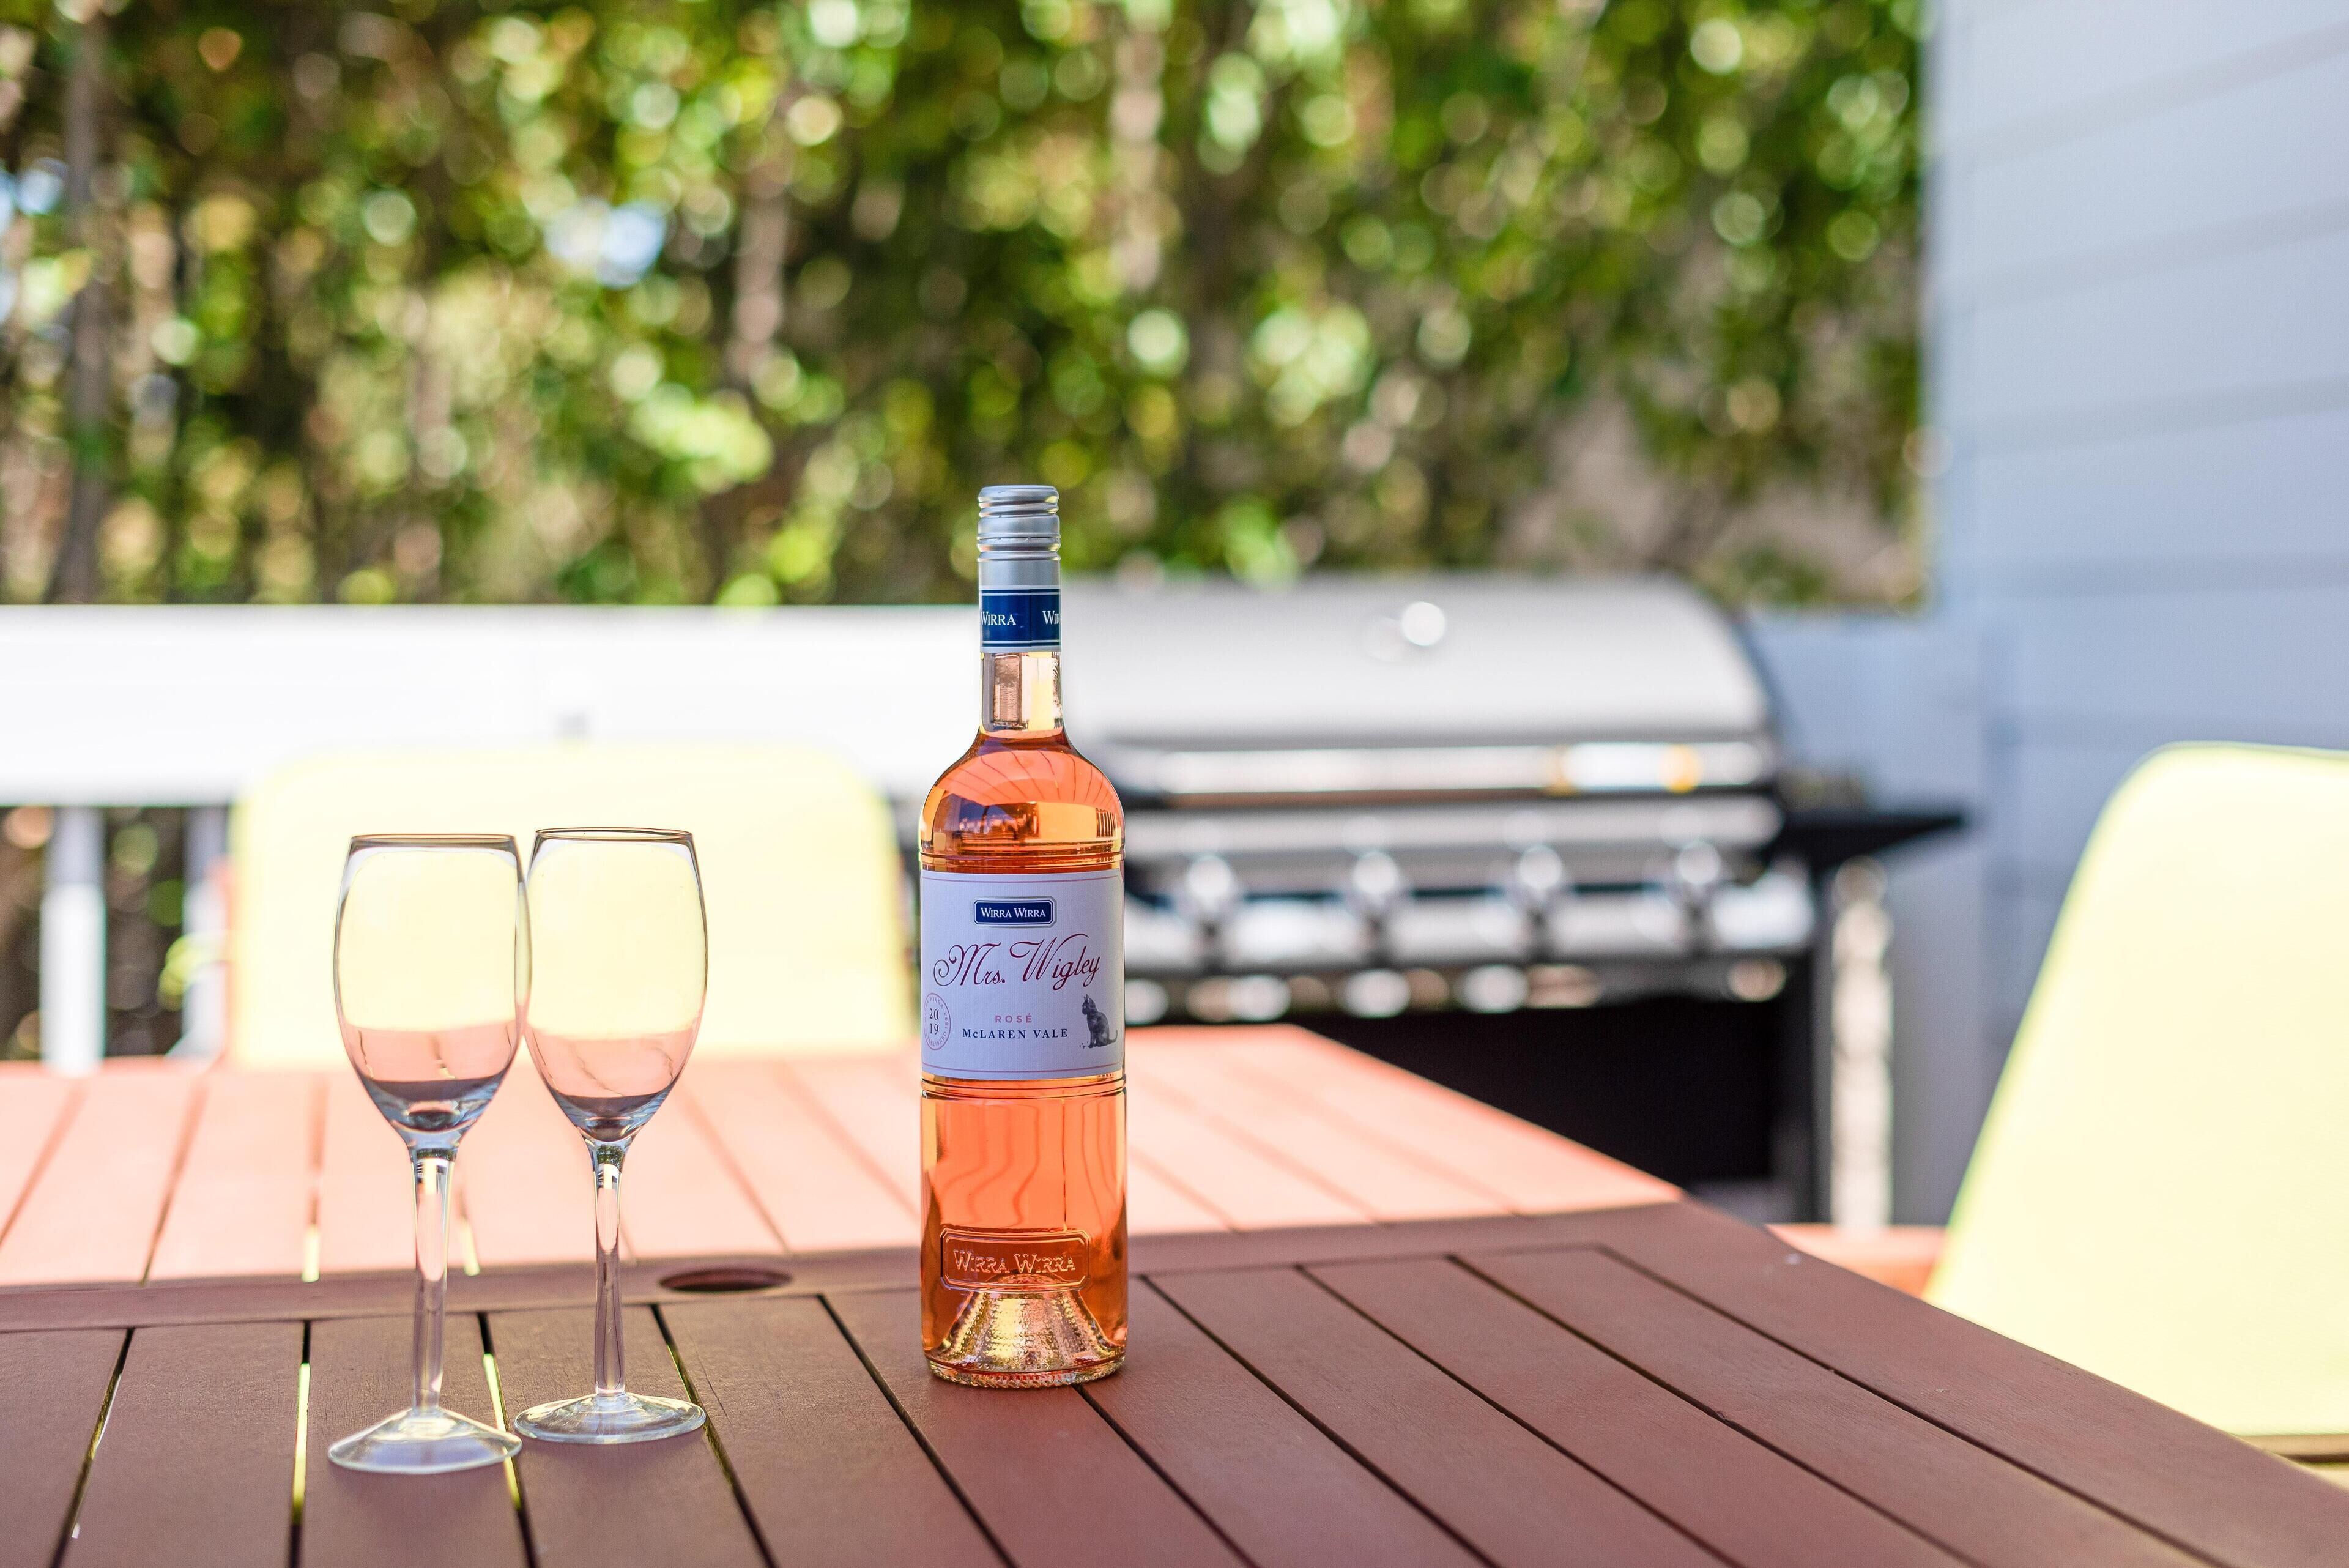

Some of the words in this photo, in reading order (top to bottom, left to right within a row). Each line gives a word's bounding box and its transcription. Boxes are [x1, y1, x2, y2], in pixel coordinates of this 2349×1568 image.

[980, 907, 1012, 918] WIRRA
[1014, 907, 1046, 918] WIRRA
[933, 942, 1006, 986] Mrs.
[1009, 933, 1101, 991] Wigley
[929, 1008, 939, 1020] 20
[995, 1013, 1033, 1024] ROSÉ
[930, 1023, 939, 1035] 19
[962, 1028, 1026, 1039] McLAREN
[1033, 1028, 1068, 1038] VALE
[953, 1248, 1011, 1274] WIRRA
[1013, 1253, 1077, 1274] WIRRA
